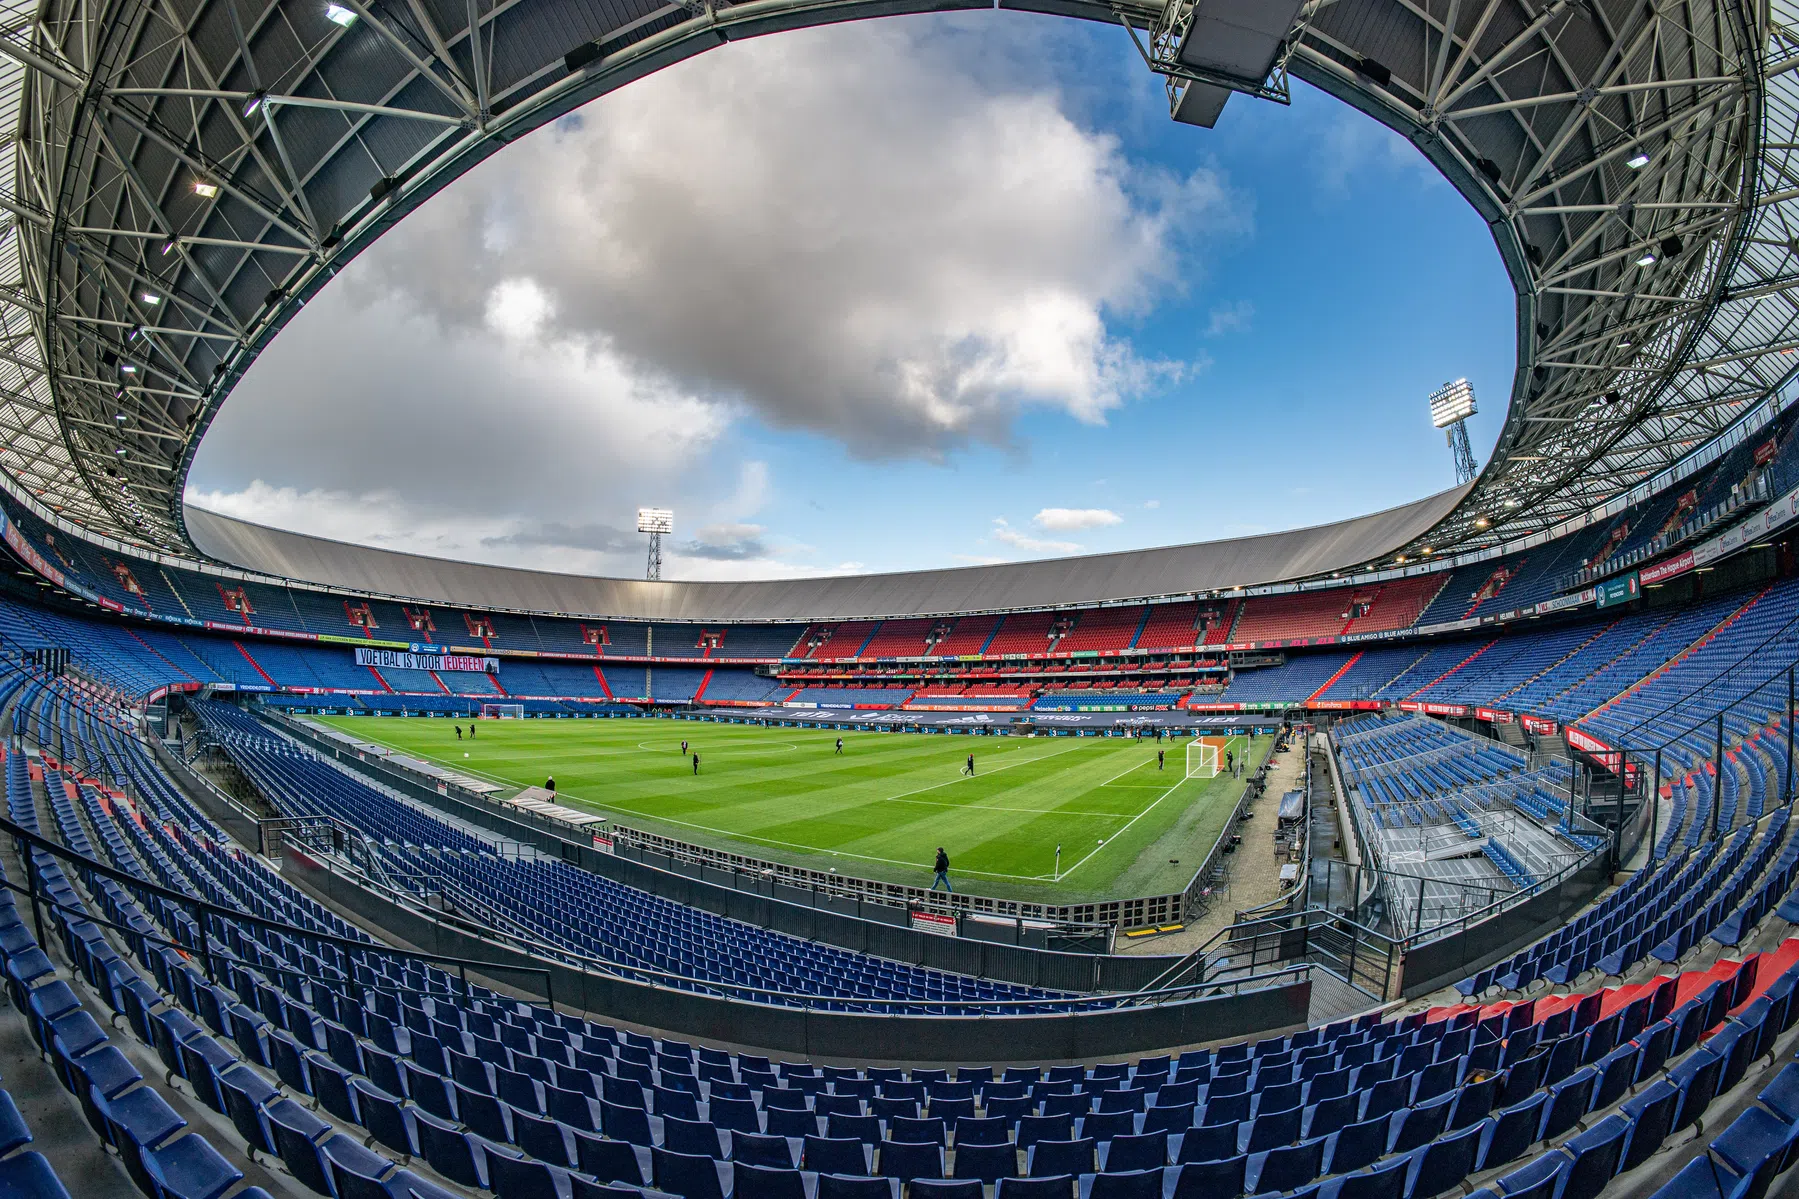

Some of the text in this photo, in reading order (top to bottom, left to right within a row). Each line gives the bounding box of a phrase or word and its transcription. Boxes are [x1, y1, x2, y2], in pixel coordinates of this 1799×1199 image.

[1641, 568, 1660, 582] Rotterdam
[1668, 562, 1679, 573] Hague
[1680, 556, 1694, 568] Airport
[361, 649, 484, 671] VOETBAL IS VOOR IEDEREEN
